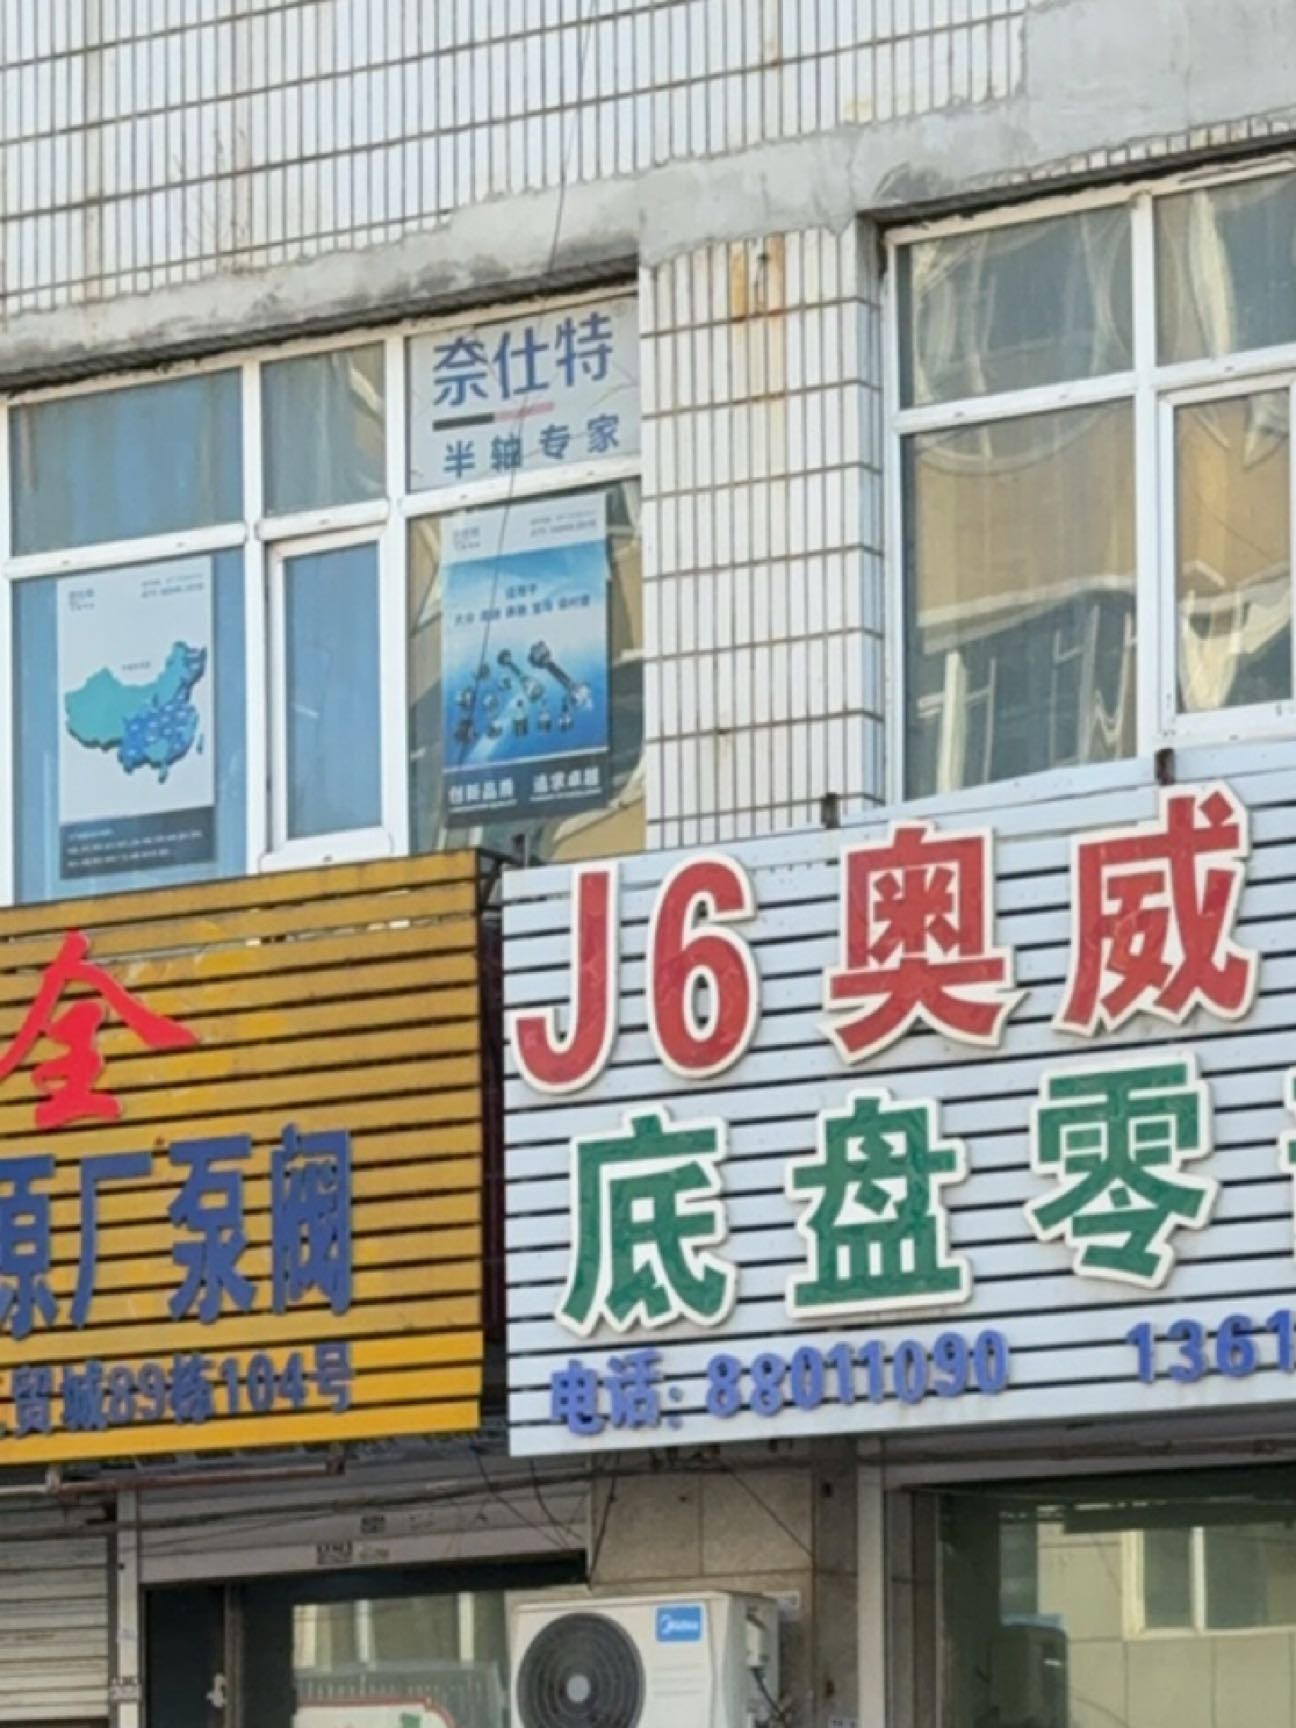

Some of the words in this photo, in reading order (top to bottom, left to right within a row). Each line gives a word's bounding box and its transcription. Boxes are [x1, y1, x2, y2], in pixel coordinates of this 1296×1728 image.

[433, 312, 613, 406] 奈仕特
[443, 413, 619, 478] 半轴专家
[0, 929, 198, 1130] 全
[0, 1122, 351, 1340] 原厂泵阀
